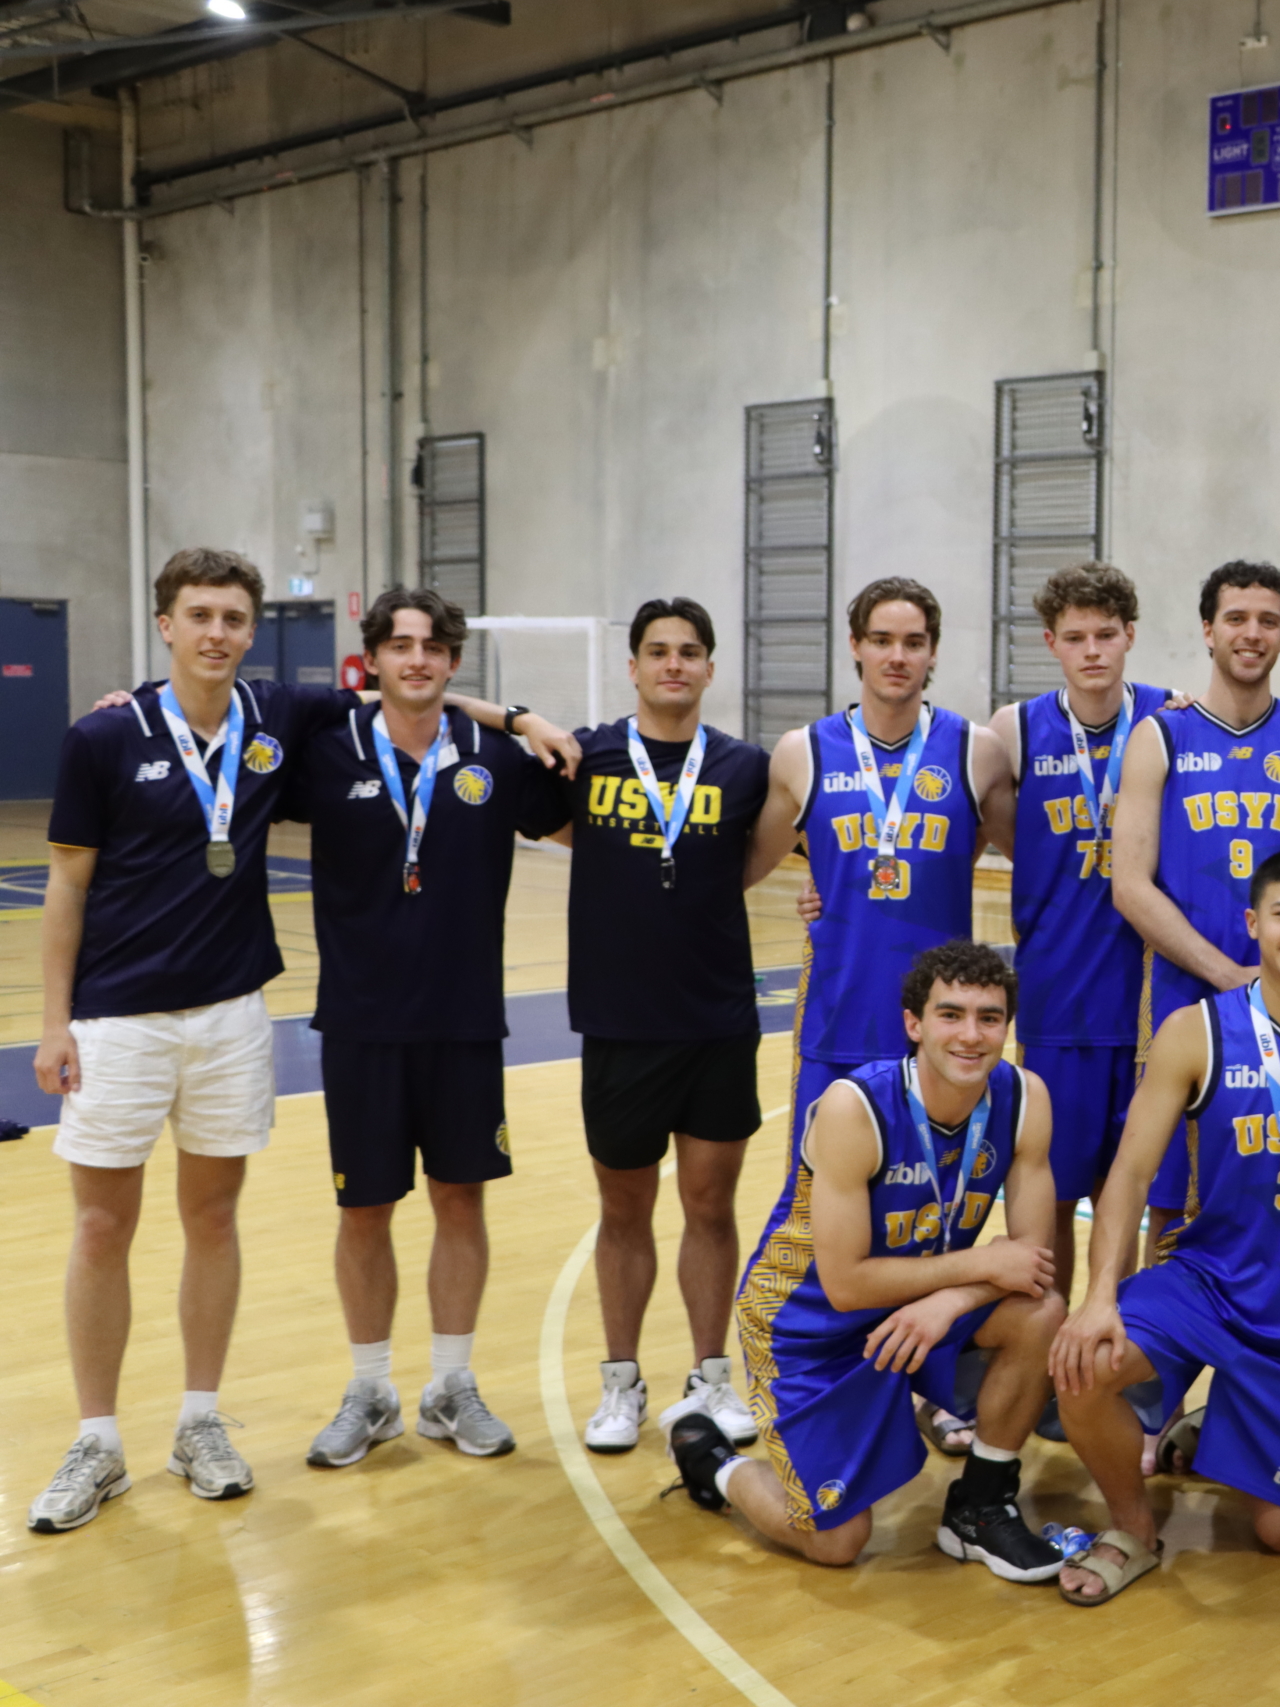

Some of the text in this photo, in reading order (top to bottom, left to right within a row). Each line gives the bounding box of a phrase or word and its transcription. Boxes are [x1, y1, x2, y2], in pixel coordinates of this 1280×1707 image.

[1213, 144, 1249, 161] LIGHT
[1034, 755, 1069, 777] ubl
[1177, 752, 1209, 773] ubl
[588, 775, 722, 825] USYD
[588, 815, 719, 835] BASKETALL
[832, 812, 950, 852] USYD
[1229, 838, 1253, 879] 9
[1225, 1065, 1267, 1088] ubl
[884, 1162, 922, 1186] ubl
